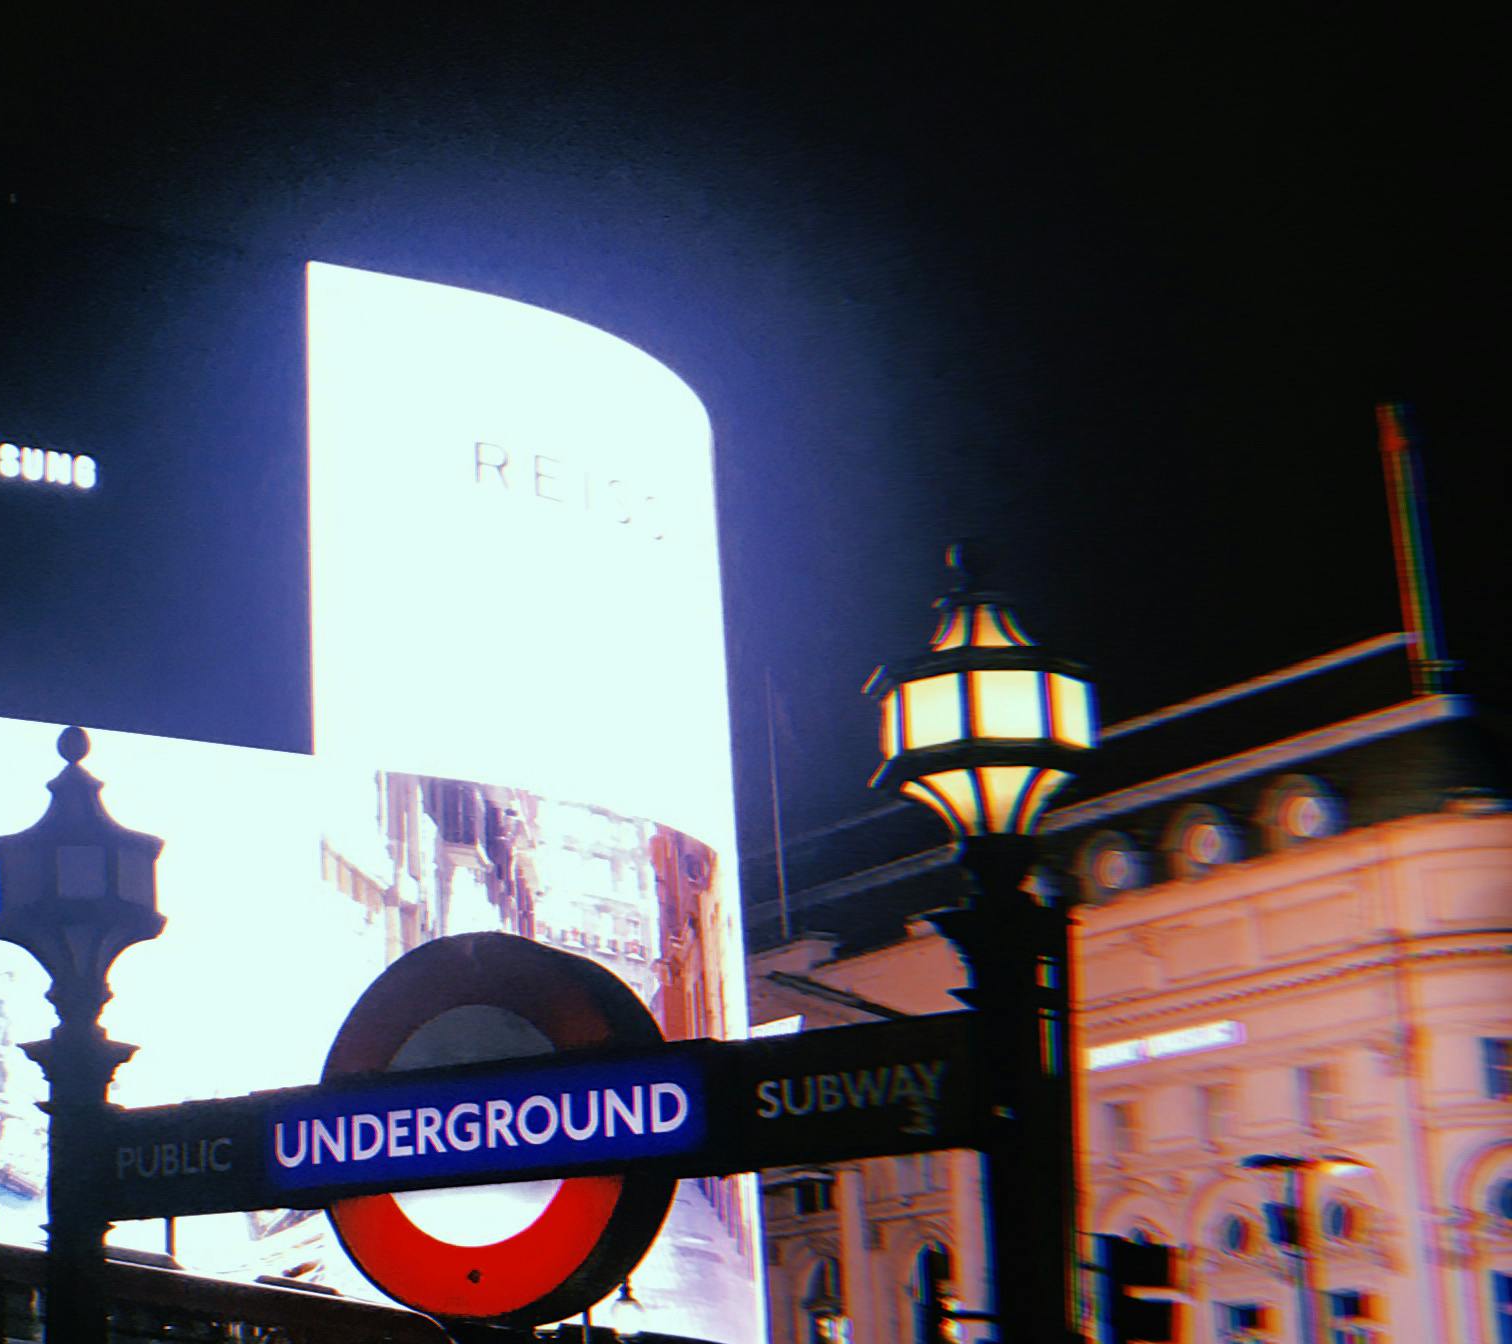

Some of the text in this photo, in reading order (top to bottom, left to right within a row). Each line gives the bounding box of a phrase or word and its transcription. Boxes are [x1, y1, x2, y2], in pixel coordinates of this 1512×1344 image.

[116, 1058, 946, 1181] PUBLIC UNDERGROUND SUBWAY
